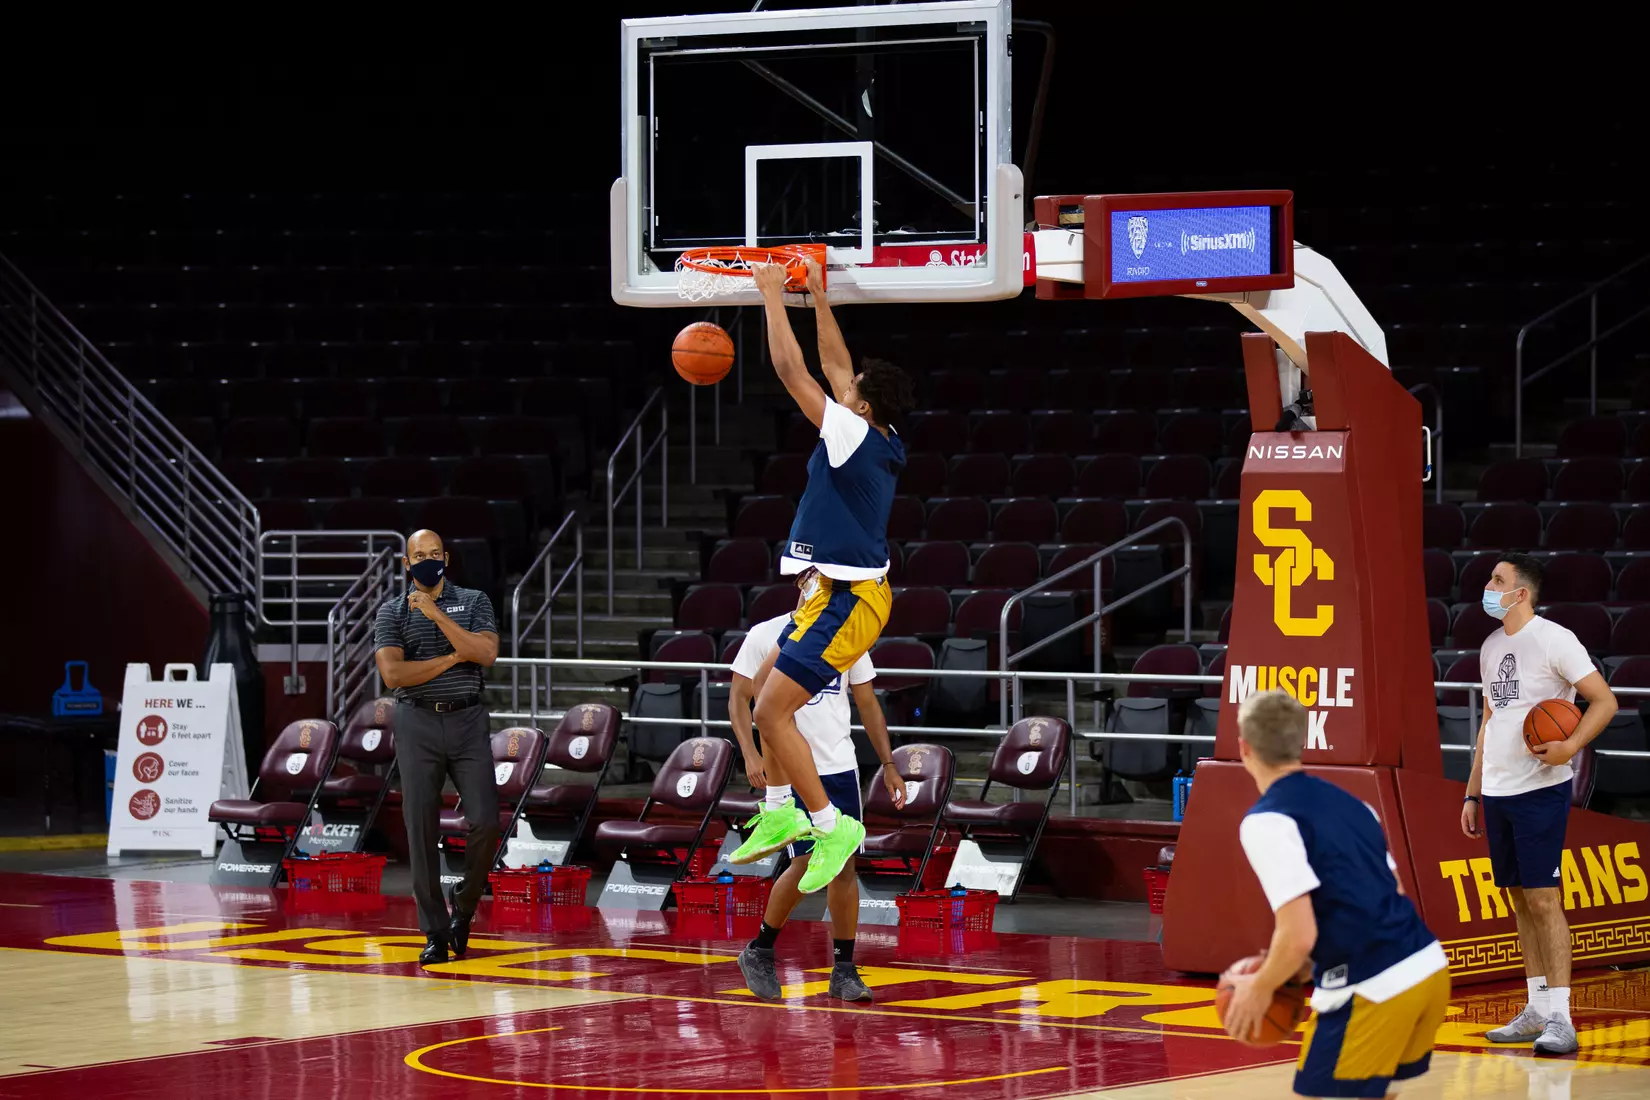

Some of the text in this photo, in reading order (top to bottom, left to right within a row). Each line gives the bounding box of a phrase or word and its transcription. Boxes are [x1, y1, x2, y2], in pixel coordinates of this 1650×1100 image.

[1249, 445, 1343, 459] NISSAN
[1253, 489, 1335, 637] SC
[446, 605, 465, 613] CBU
[1229, 664, 1355, 708] MUSCLE
[145, 698, 174, 708] HERE
[176, 698, 193, 708] WE
[172, 723, 188, 731] Stay
[192, 733, 211, 741] apart
[168, 760, 189, 768] Cover
[164, 797, 193, 805] Sanitize
[309, 836, 343, 847] Mortgage
[218, 863, 272, 873] POWERADE
[605, 883, 665, 896] POWERADE
